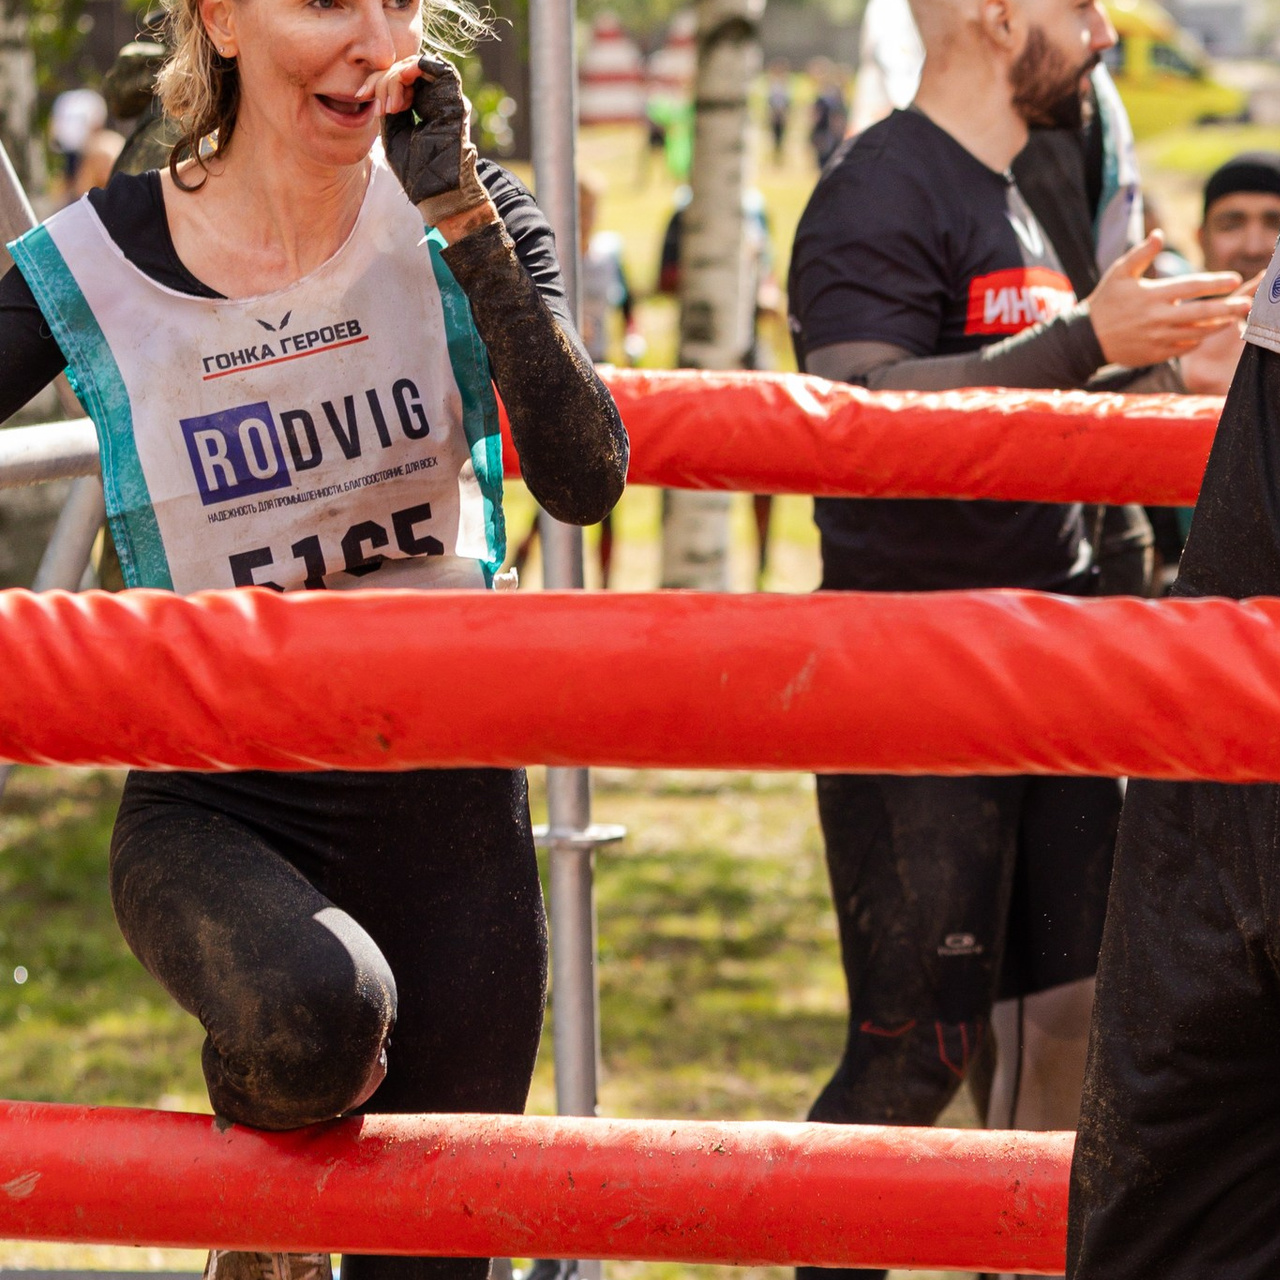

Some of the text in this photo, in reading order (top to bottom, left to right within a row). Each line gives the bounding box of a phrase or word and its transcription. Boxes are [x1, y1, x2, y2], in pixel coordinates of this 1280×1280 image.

[202, 319, 363, 373] ГОНКА ГЕРОЕВ
[190, 377, 431, 493] RODVIG
[207, 503, 257, 524] НАДЕЖНОСТЬ
[258, 498, 275, 514] ДЛЯ
[343, 464, 404, 492] БЛАГОСОСТОЯНИЕ
[405, 461, 420, 476] ДЛЯ
[419, 456, 438, 470] ВСЕХ
